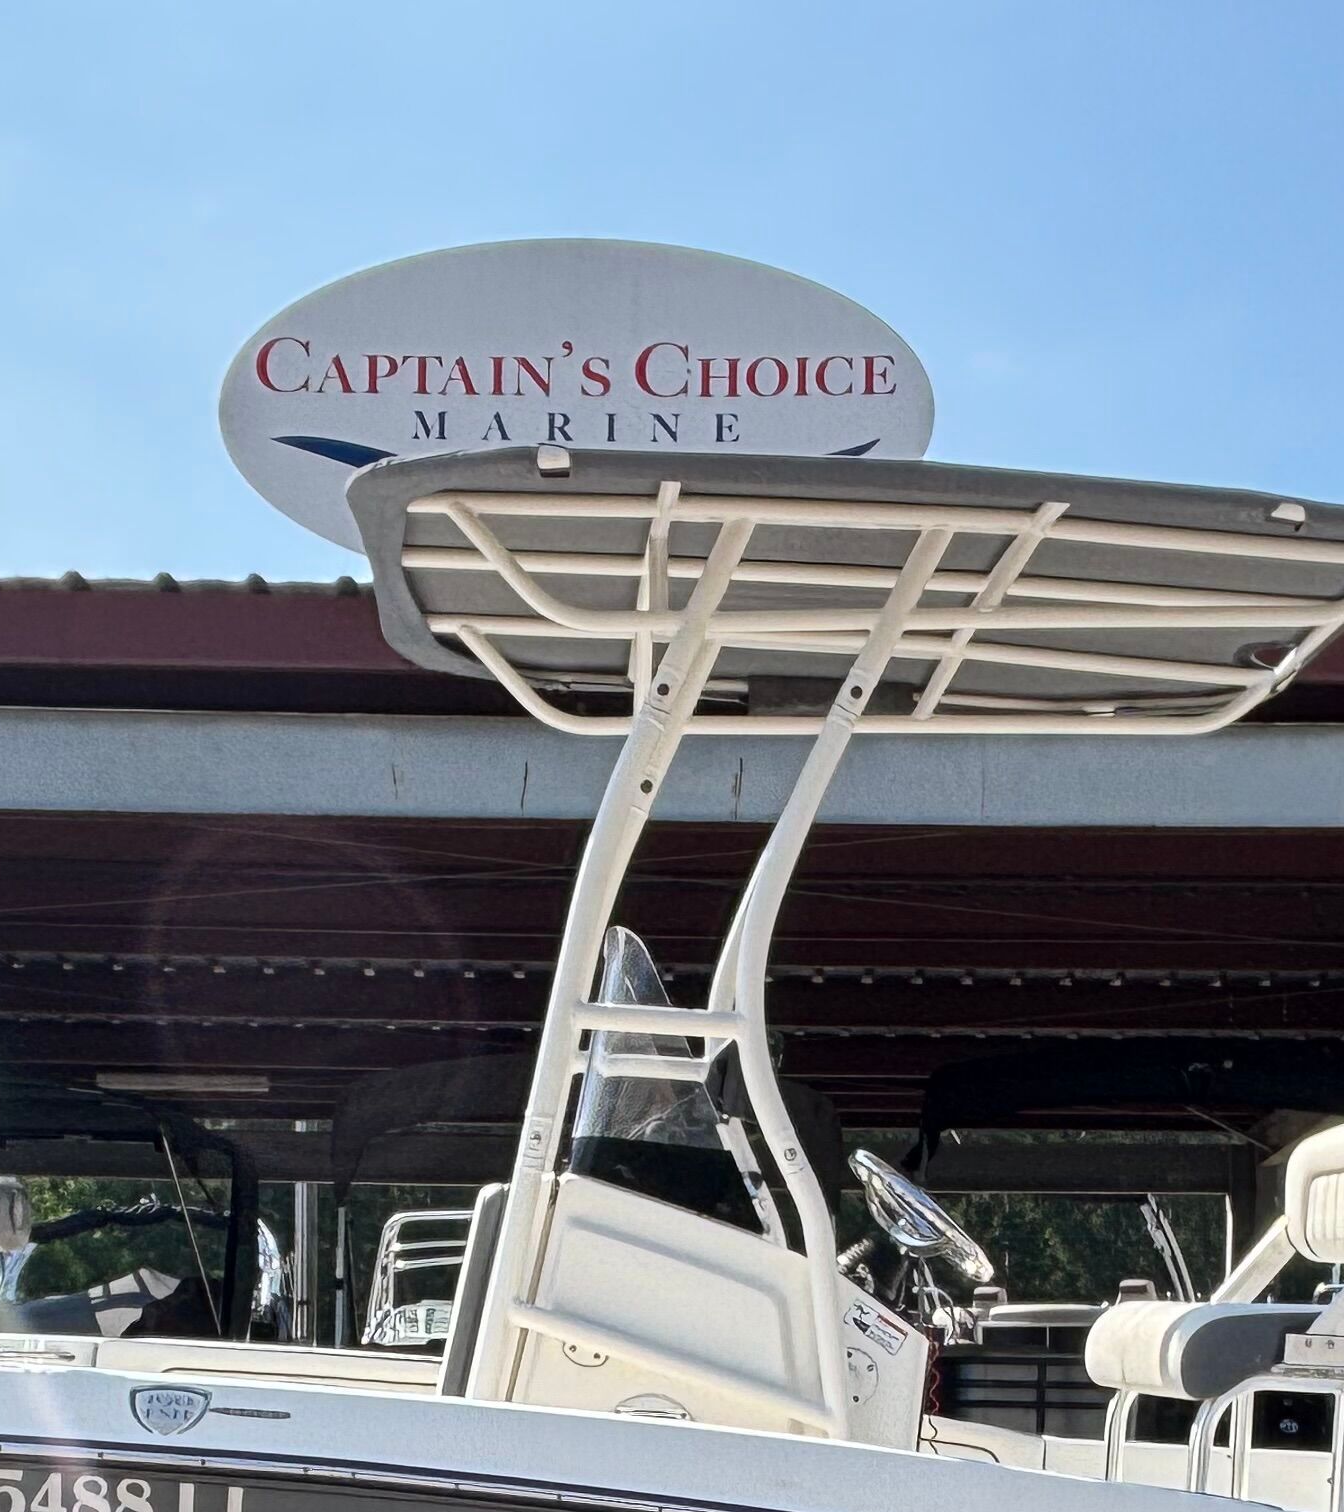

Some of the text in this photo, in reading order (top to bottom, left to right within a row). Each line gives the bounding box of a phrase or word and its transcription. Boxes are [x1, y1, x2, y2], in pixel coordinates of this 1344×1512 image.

[256, 337, 897, 398] CAPTAIN'S CHOICE
[412, 411, 740, 442] MARINE
